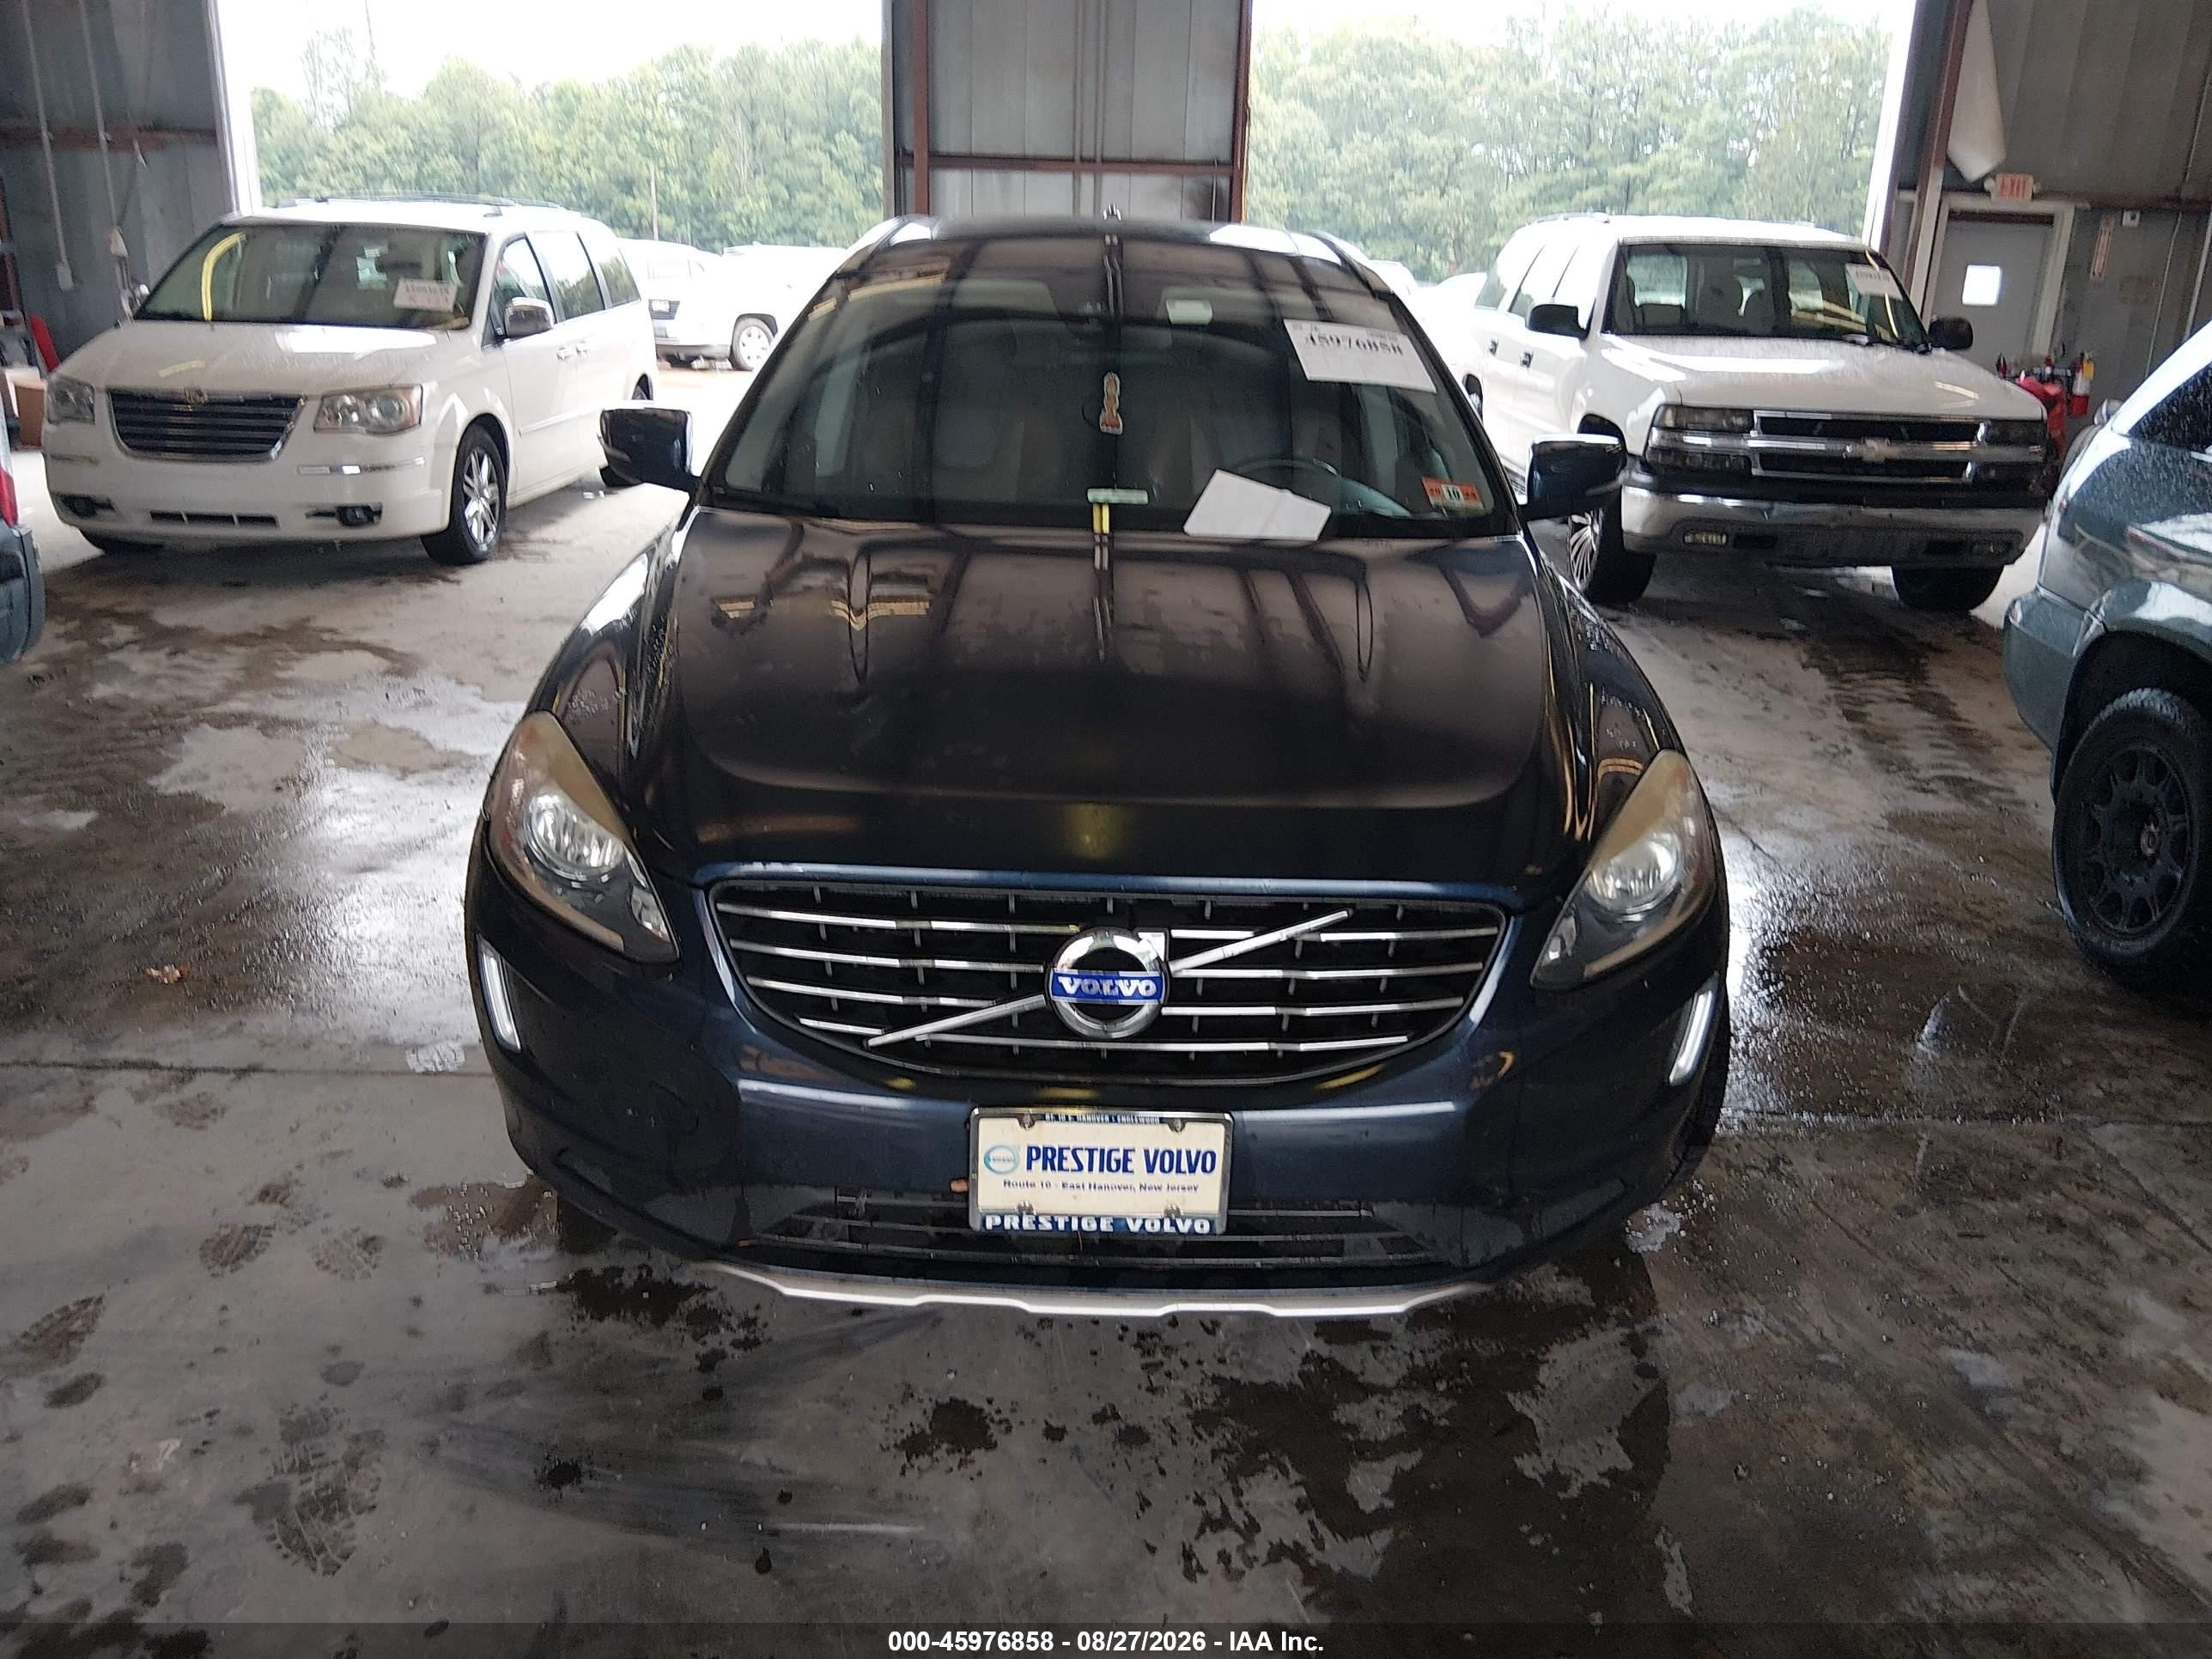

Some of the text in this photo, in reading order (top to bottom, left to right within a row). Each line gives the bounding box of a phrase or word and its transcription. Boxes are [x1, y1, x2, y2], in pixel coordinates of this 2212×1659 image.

[1058, 975, 1157, 997] VOLVO
[1026, 1146, 1217, 1175] PRESTIGE VOLVO
[1003, 1179, 1036, 1189] Route
[1040, 1181, 1052, 1190] 10
[1061, 1182, 1085, 1191] East
[1139, 1182, 1162, 1192] New
[1167, 1183, 1199, 1193] Jersey
[985, 1214, 1211, 1235] PRESTIGE VOLVO
